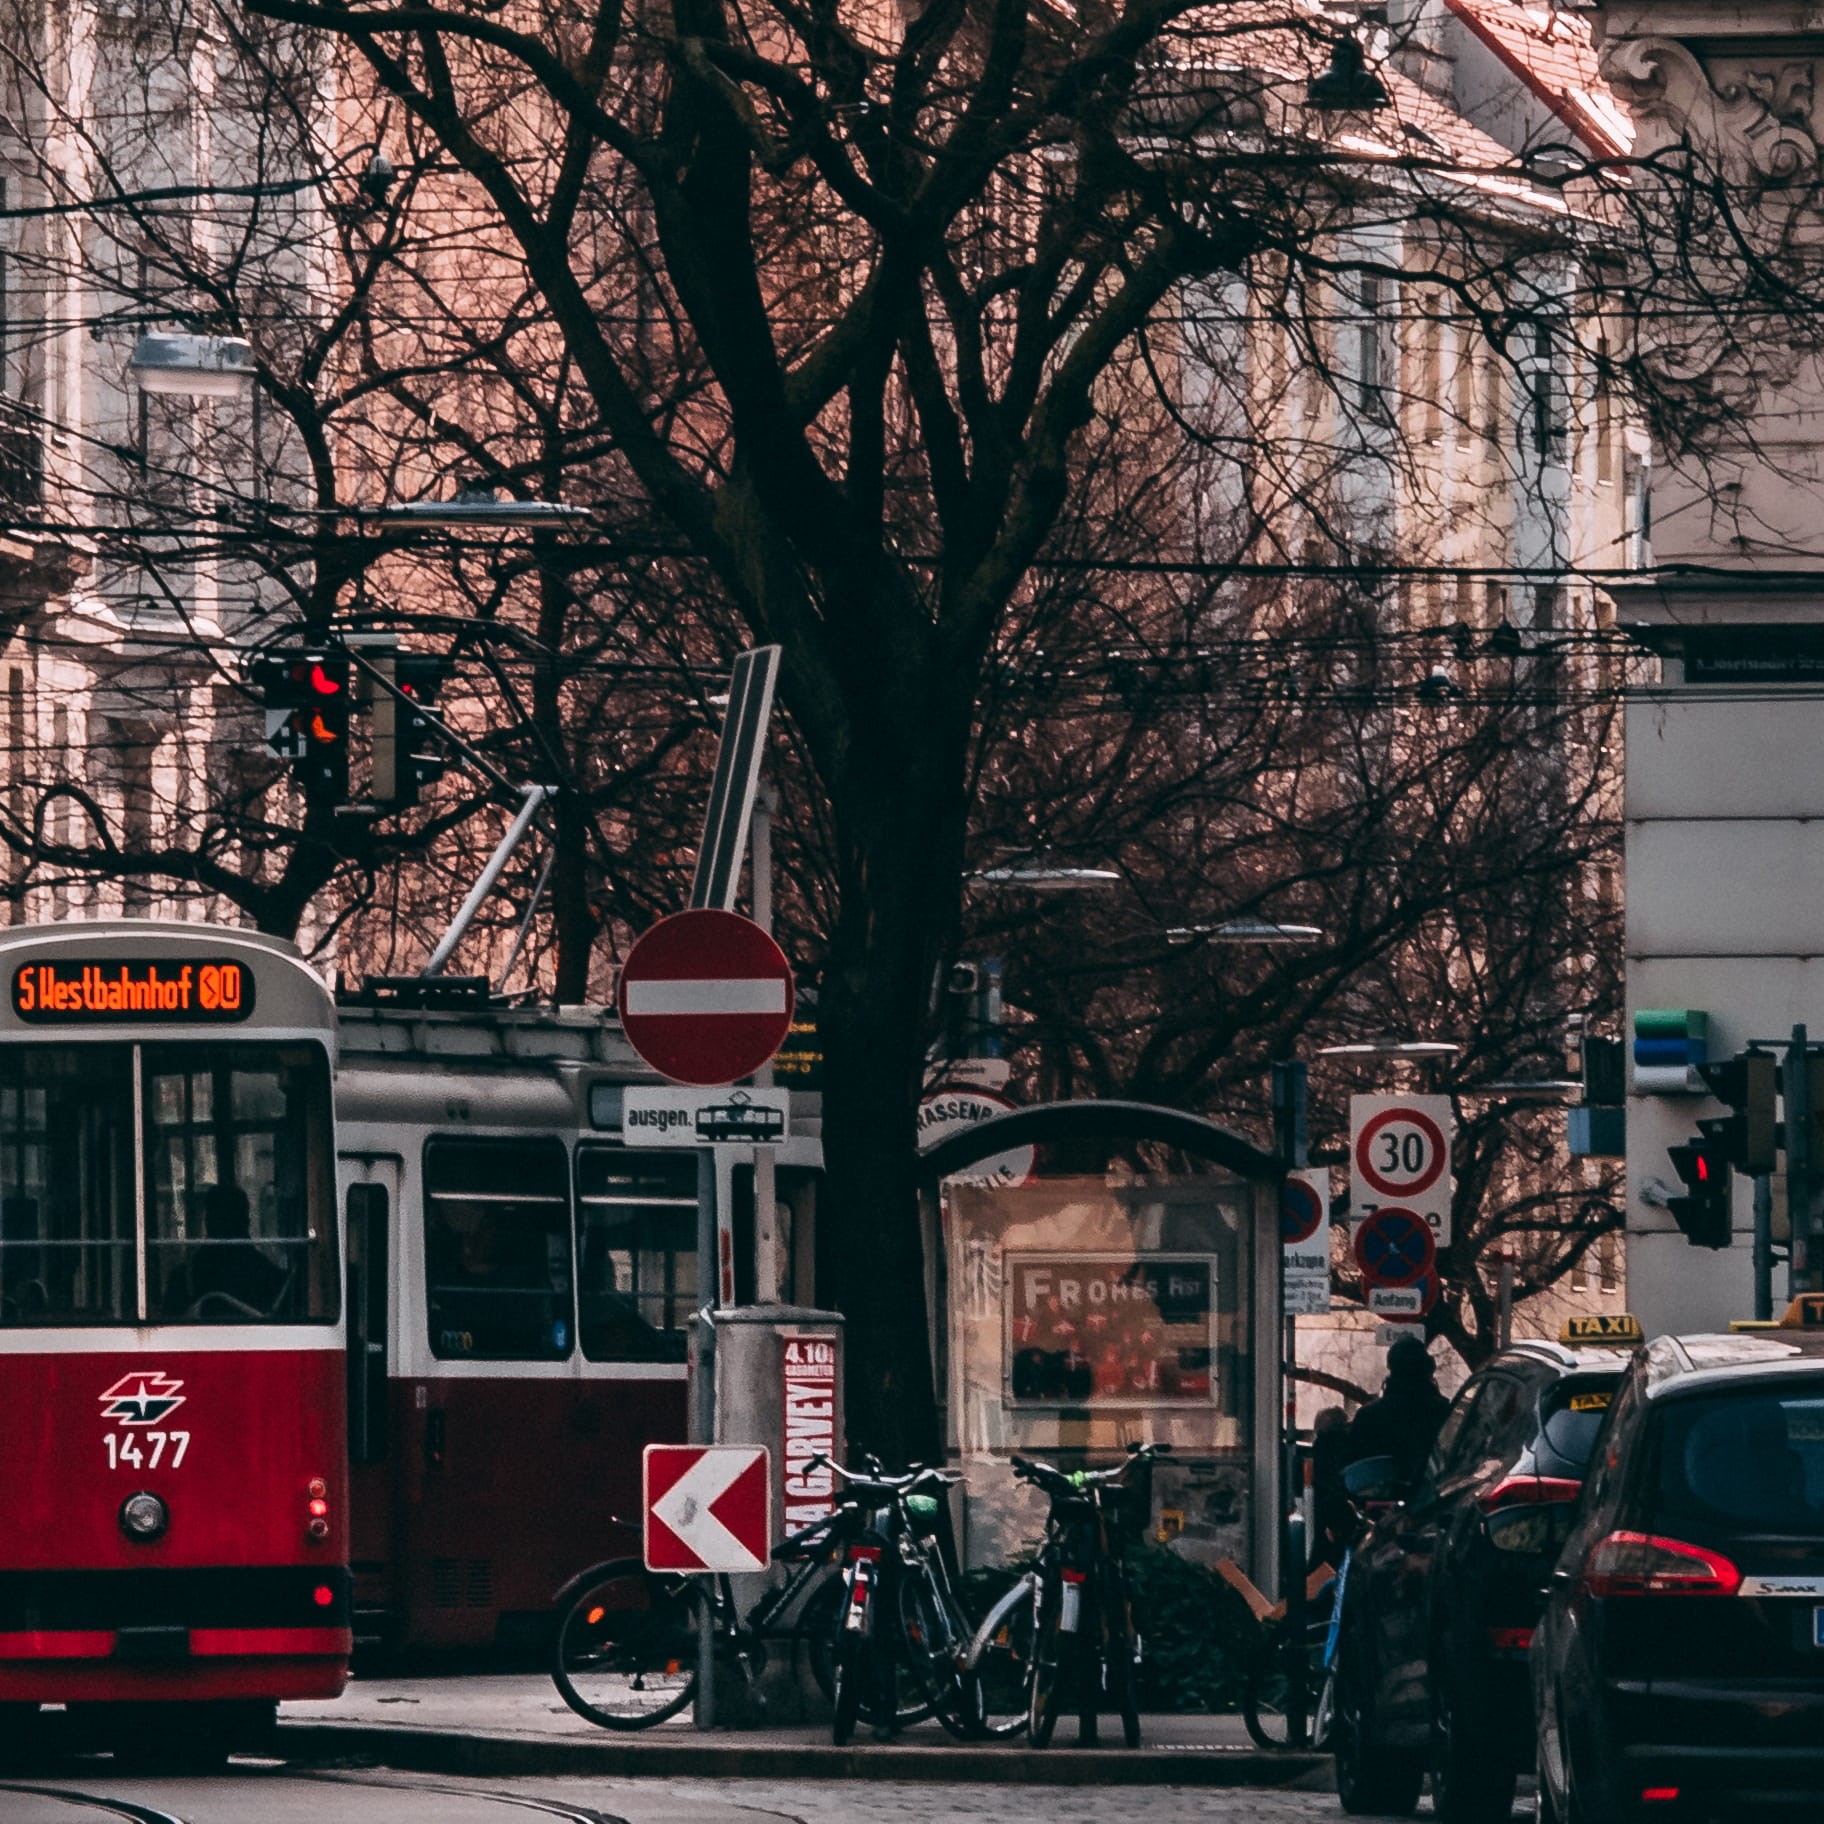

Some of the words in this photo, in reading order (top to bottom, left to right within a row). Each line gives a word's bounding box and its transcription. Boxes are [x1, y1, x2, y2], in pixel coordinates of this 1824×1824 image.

[39, 965, 192, 1010] Westbahnhof
[628, 1108, 694, 1133] ausgen.
[1379, 1132, 1424, 1174] 30
[1572, 1316, 1631, 1335] TAXI
[103, 1431, 191, 1469] 1477
[785, 1382, 833, 1497] GARVEY
